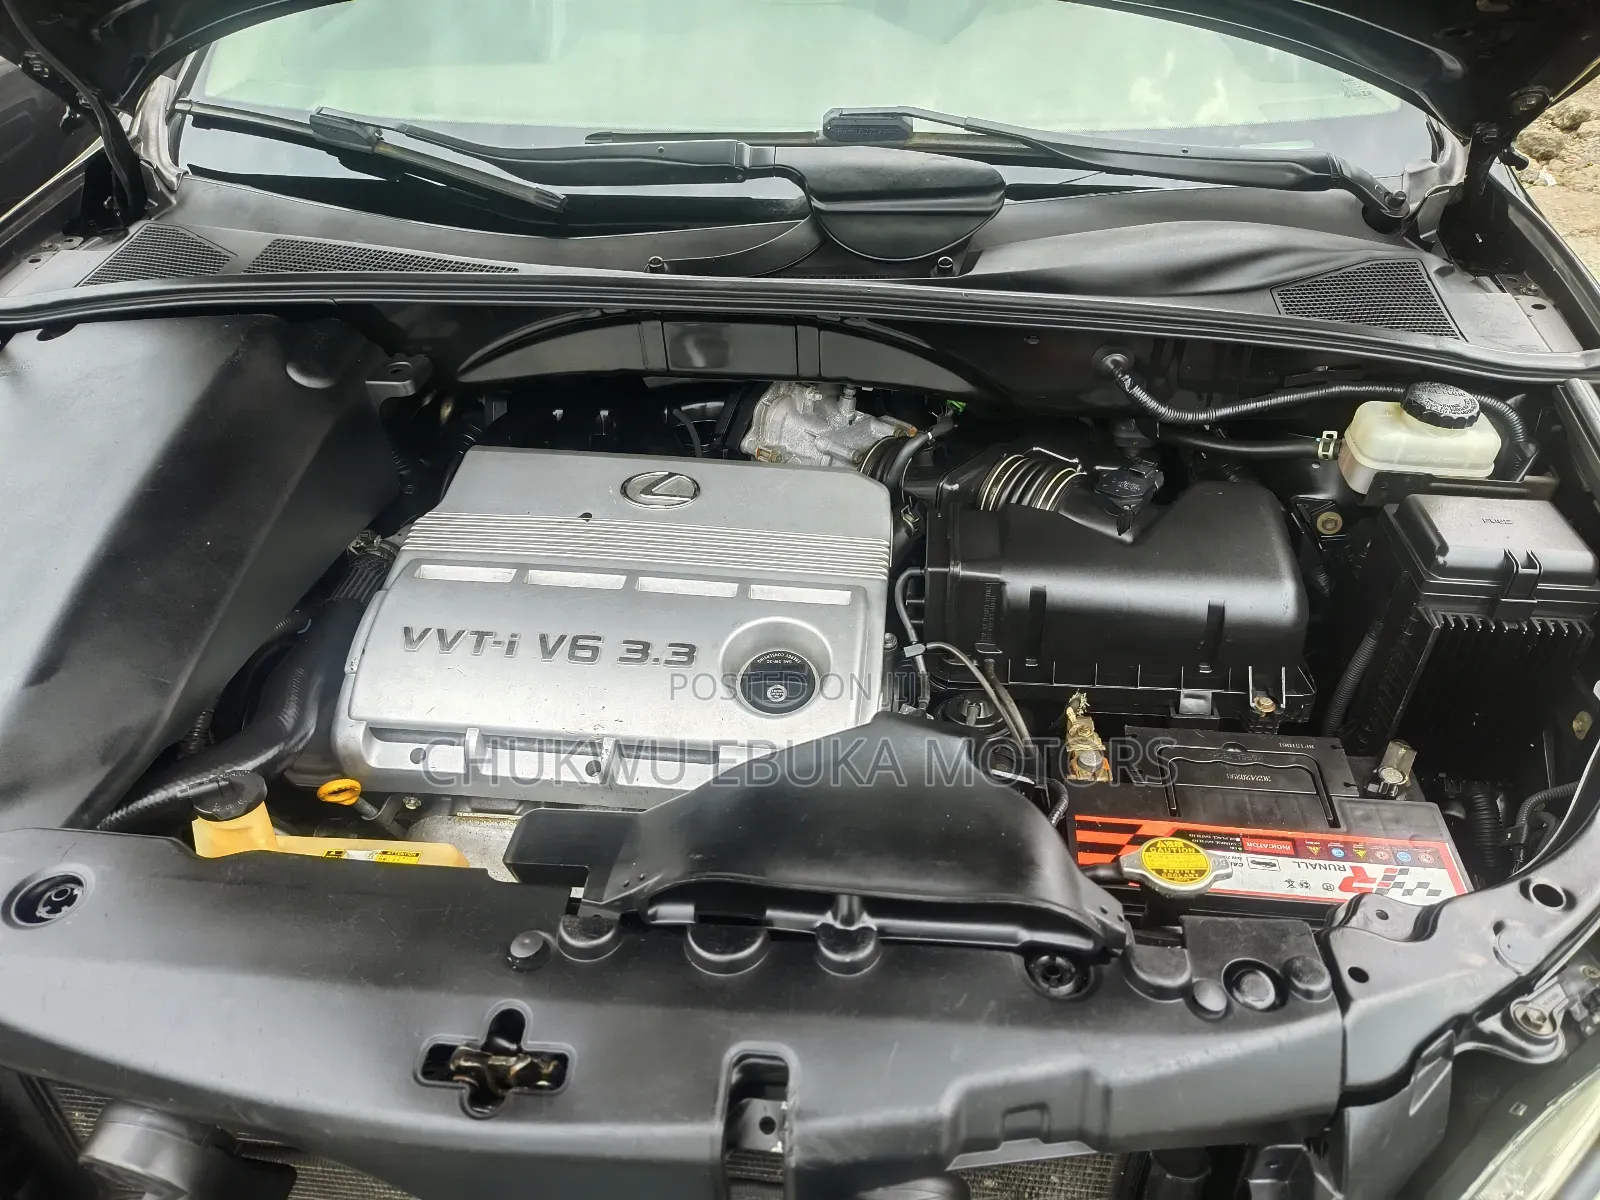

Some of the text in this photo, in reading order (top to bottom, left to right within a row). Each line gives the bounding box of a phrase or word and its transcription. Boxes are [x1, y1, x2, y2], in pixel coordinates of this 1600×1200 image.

[402, 626, 698, 668] VVT-i V6 3.3
[1245, 841, 1291, 851] INDICATOR
[1292, 860, 1347, 873] RUNALL
